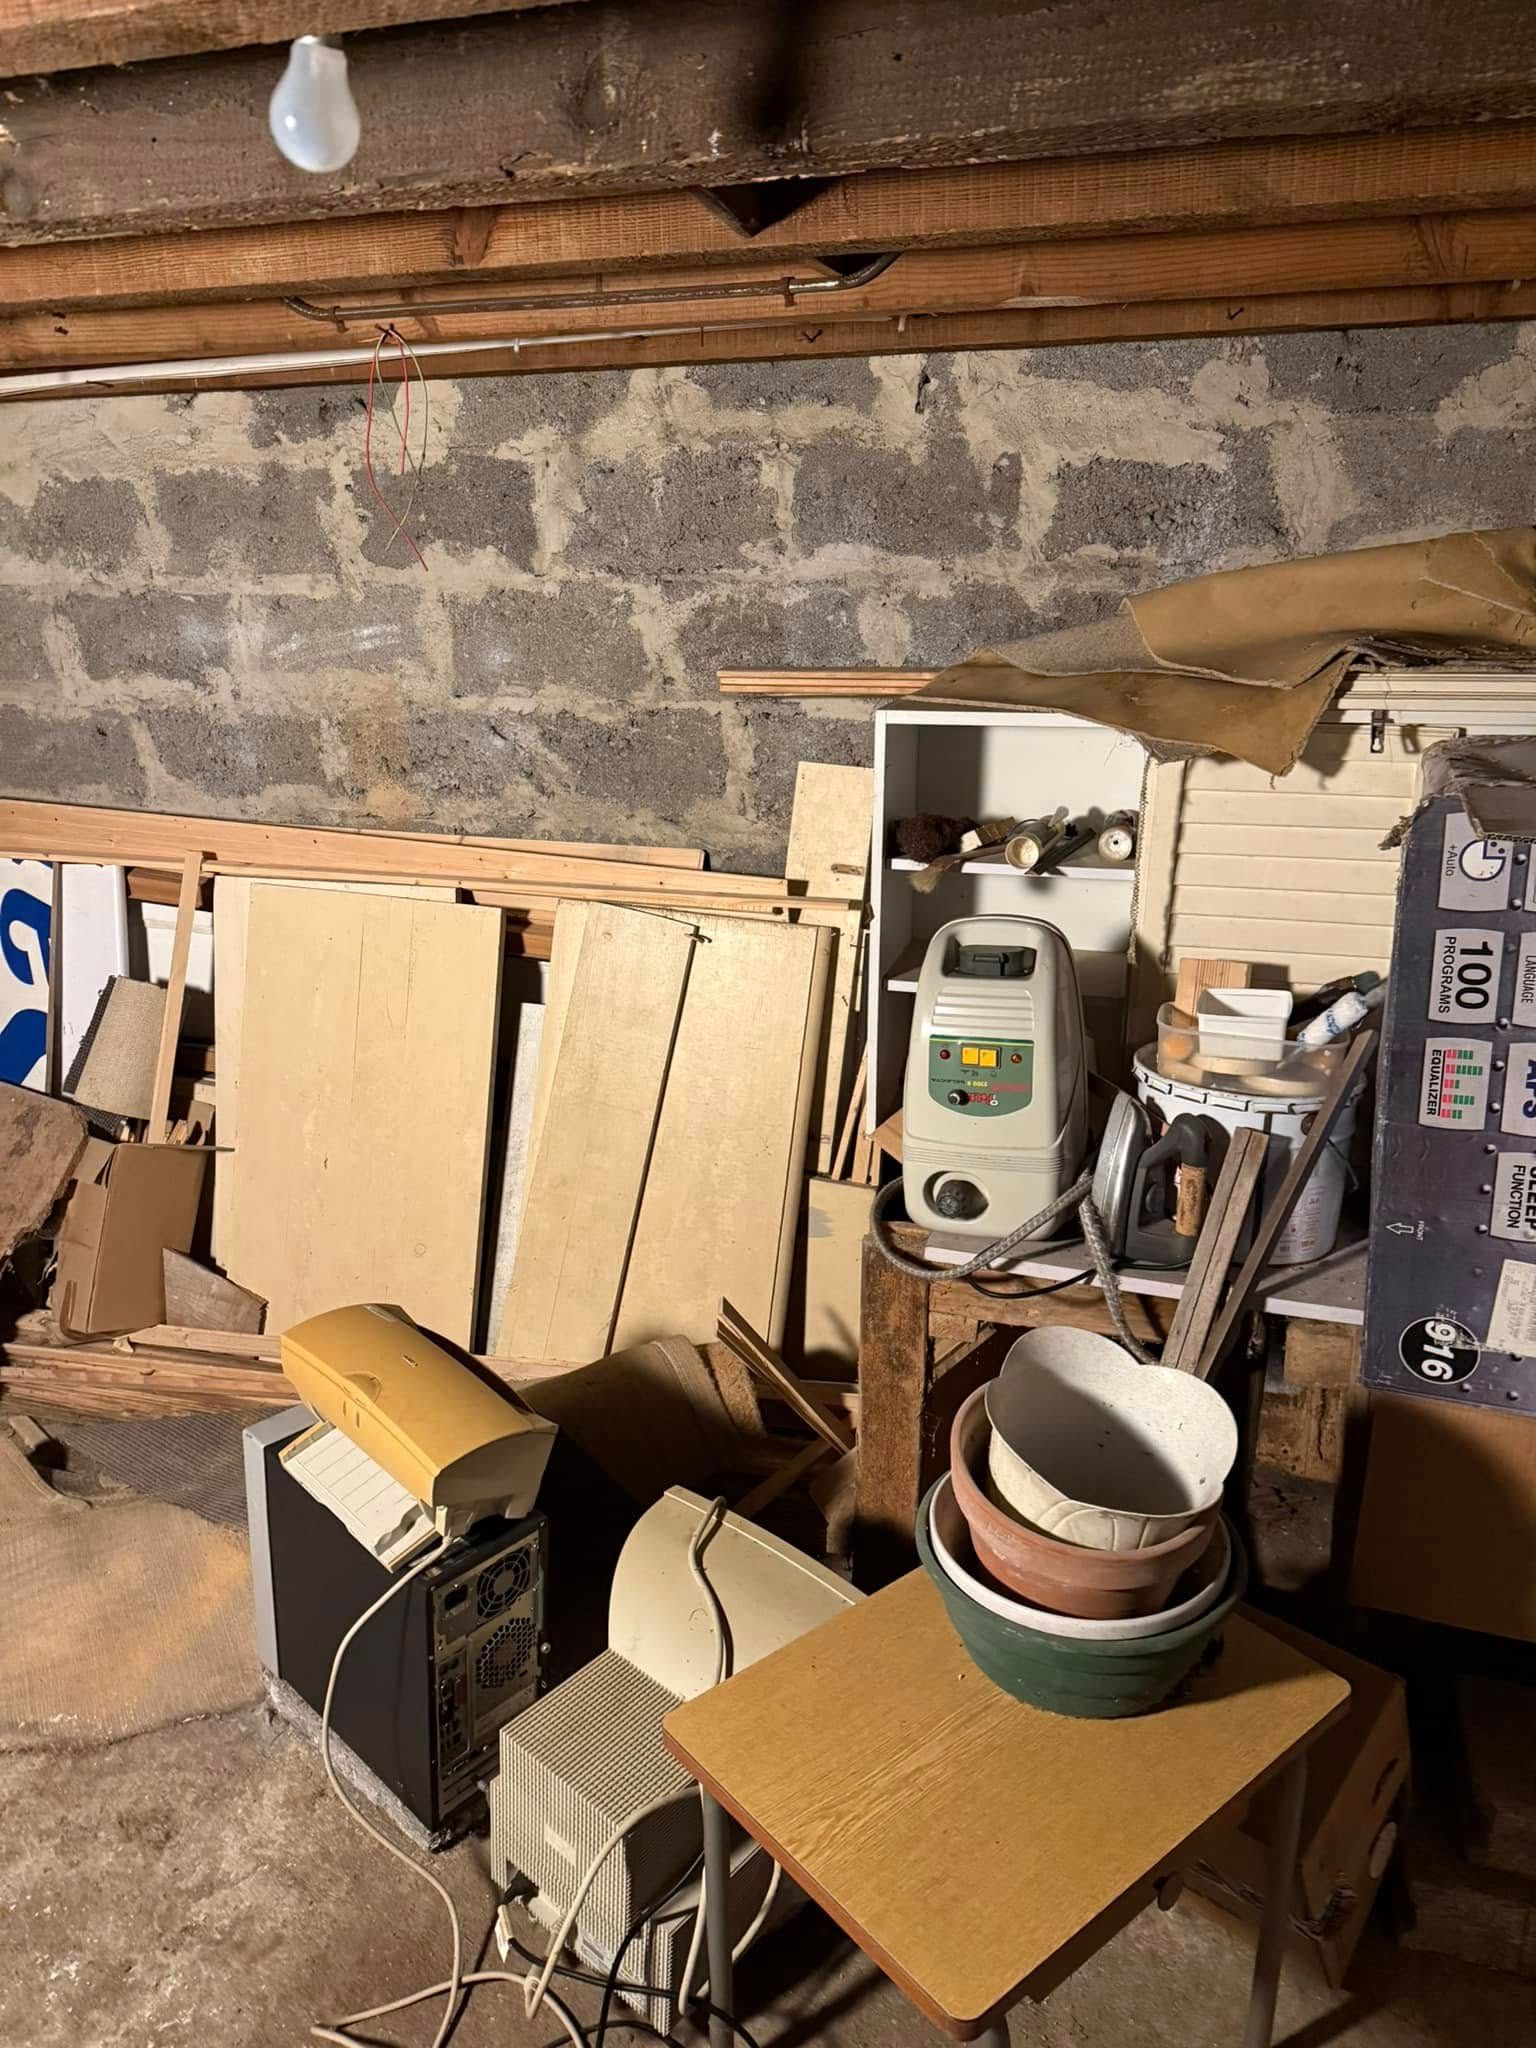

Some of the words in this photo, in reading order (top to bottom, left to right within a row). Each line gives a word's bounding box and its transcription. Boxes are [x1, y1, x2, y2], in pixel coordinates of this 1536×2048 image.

[1445, 844, 1458, 877] +Auto
[1438, 936, 1457, 1014] PROGRAMS
[1456, 941, 1494, 1009] 100
[1520, 954, 1535, 1004] LANGUAGE
[1427, 1049, 1442, 1116] EQUALIZER
[1507, 1164, 1527, 1229] FUNCTION
[1415, 1220, 1425, 1241] FRONT
[1421, 1320, 1457, 1381] 916
